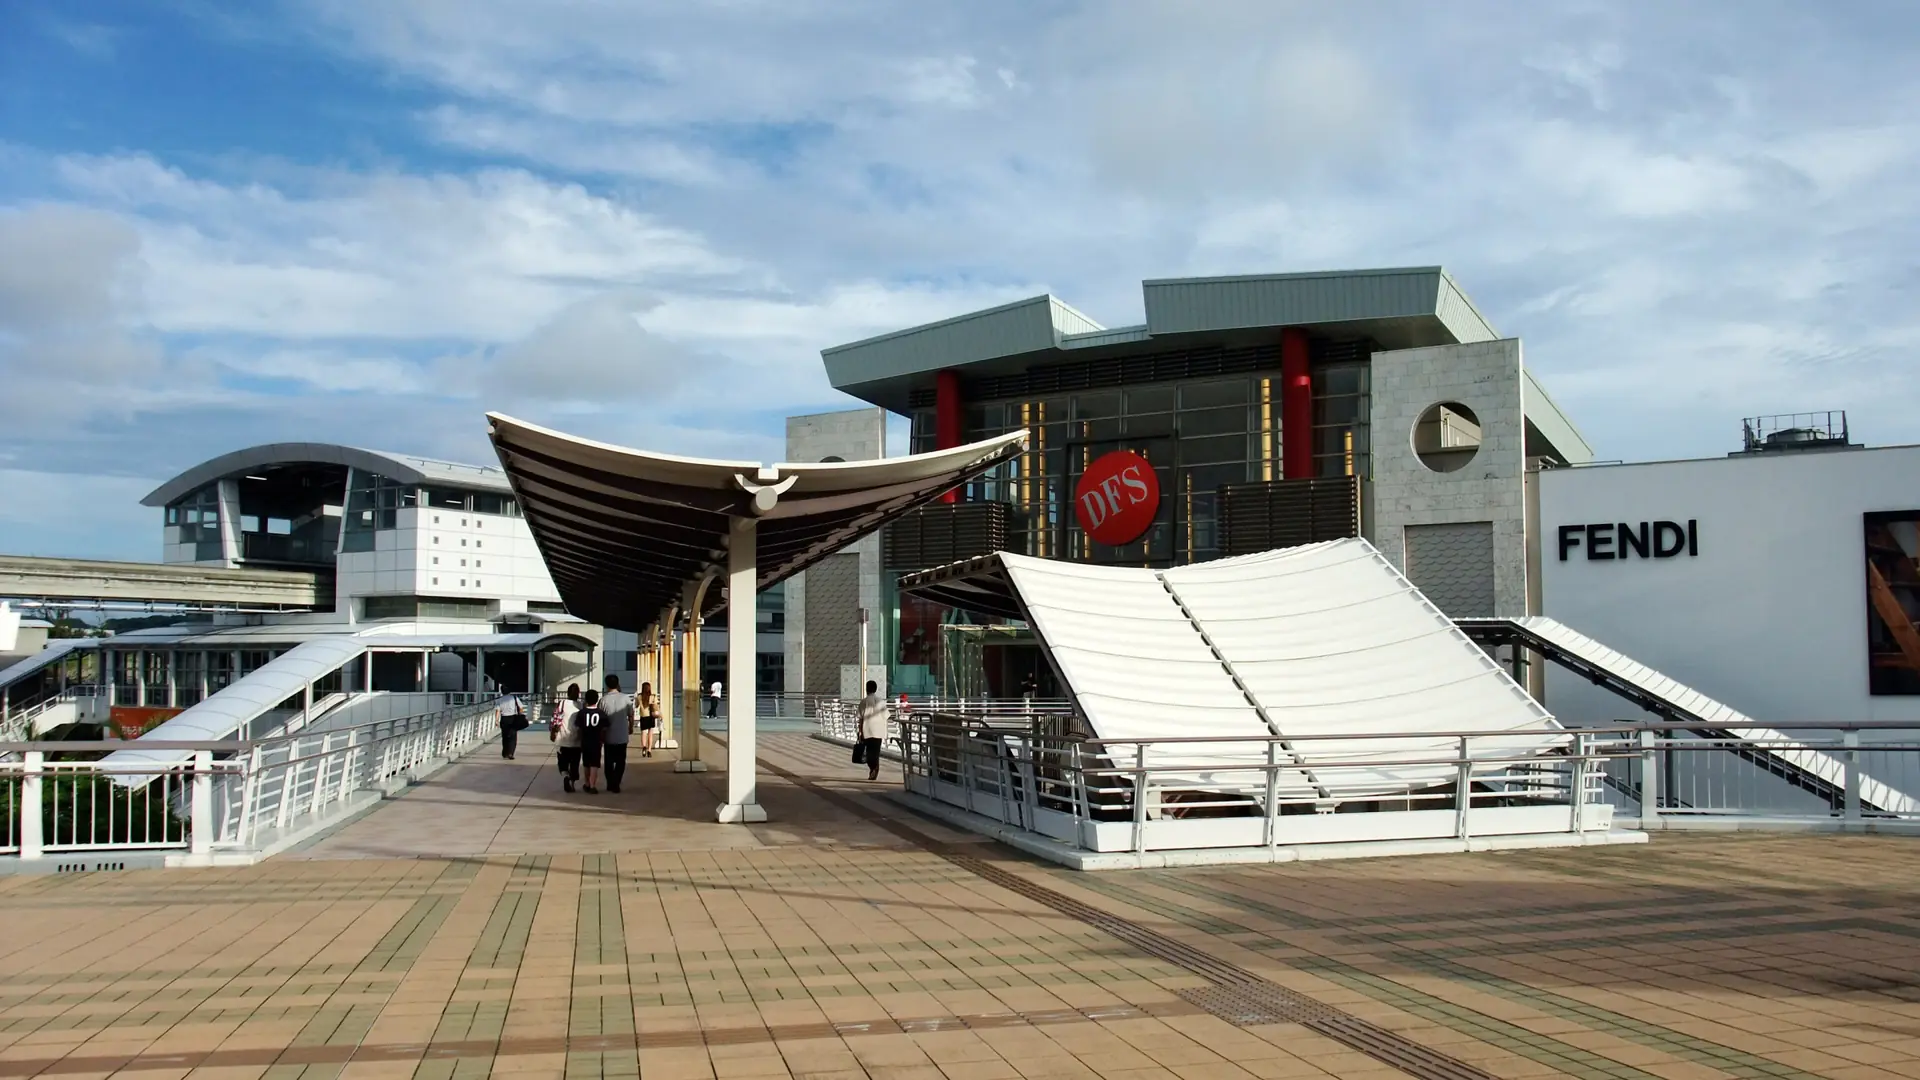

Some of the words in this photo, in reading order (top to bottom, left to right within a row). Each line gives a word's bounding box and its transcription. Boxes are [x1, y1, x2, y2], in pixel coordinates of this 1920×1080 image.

[1081, 465, 1148, 530] DFS
[1558, 519, 1699, 561] FENDI
[586, 713, 600, 727] 10
